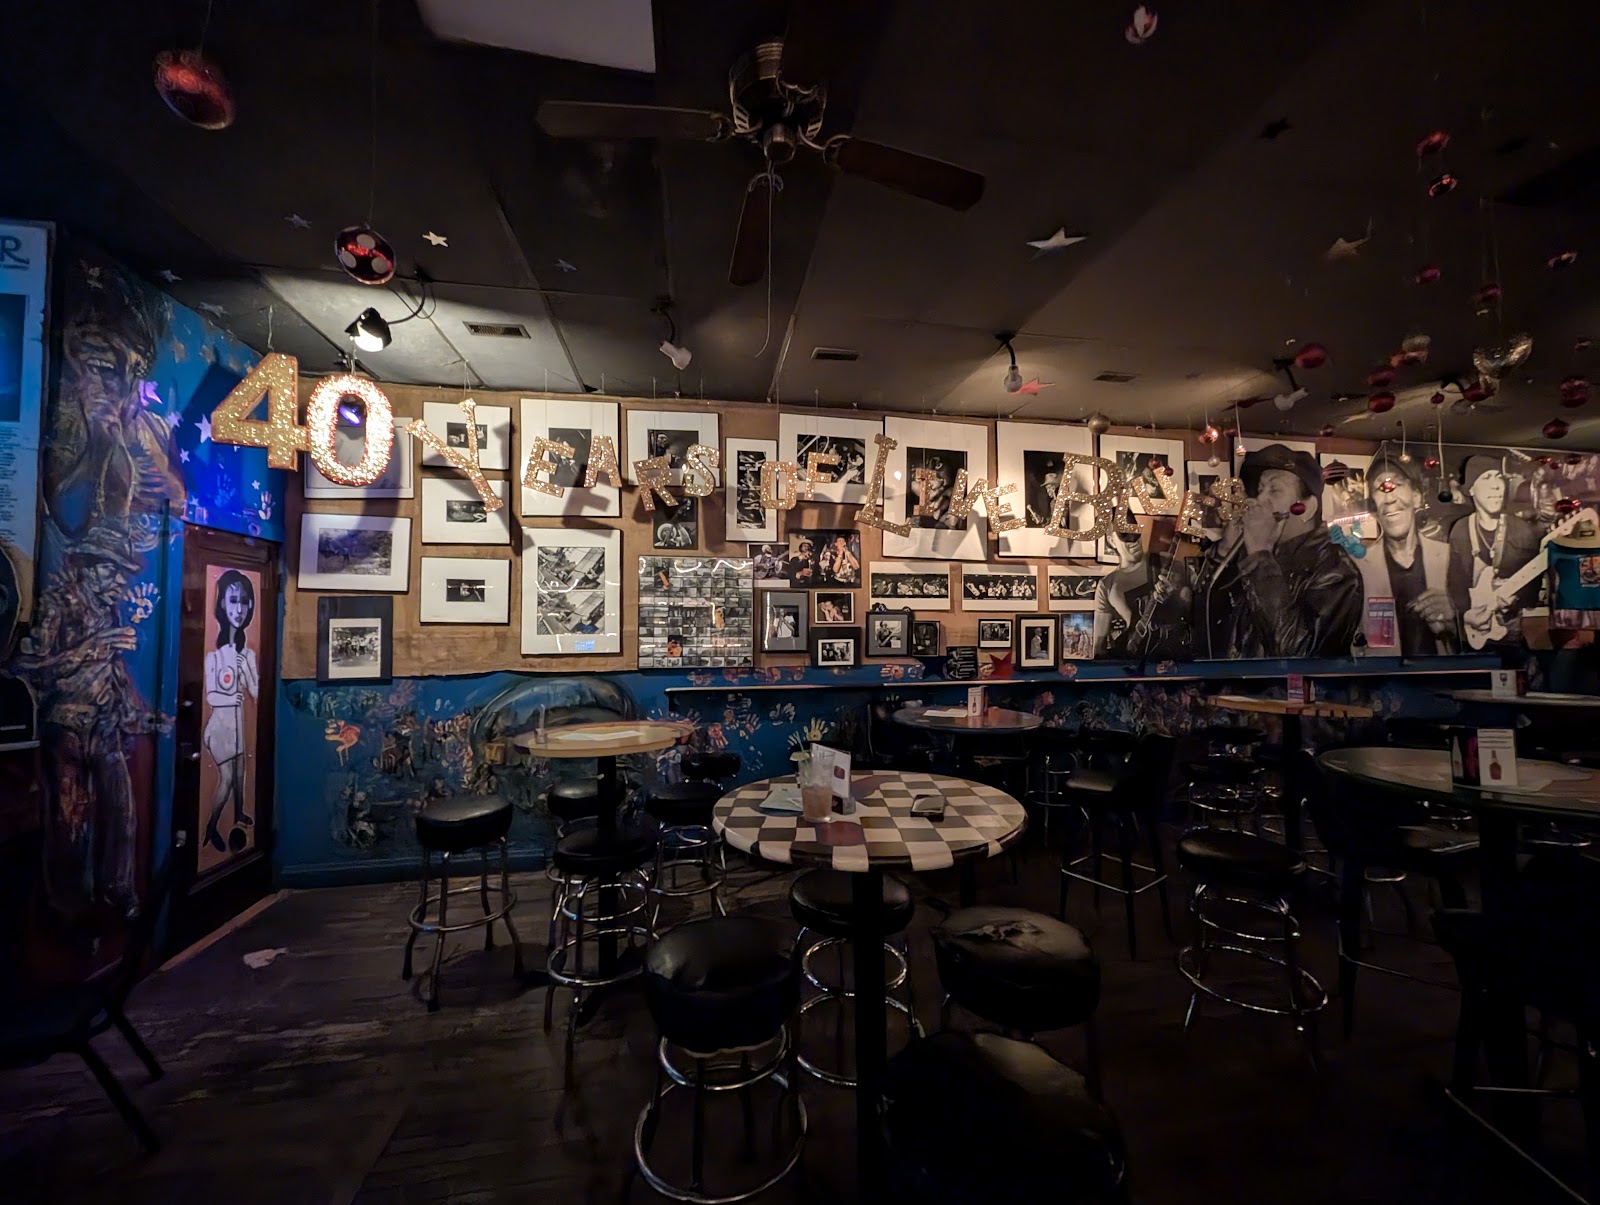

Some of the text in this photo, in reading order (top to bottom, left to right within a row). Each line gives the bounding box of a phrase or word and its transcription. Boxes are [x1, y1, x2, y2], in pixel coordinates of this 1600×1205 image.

[211, 353, 1248, 542] 40 YEARS OF LIVE BLUES
